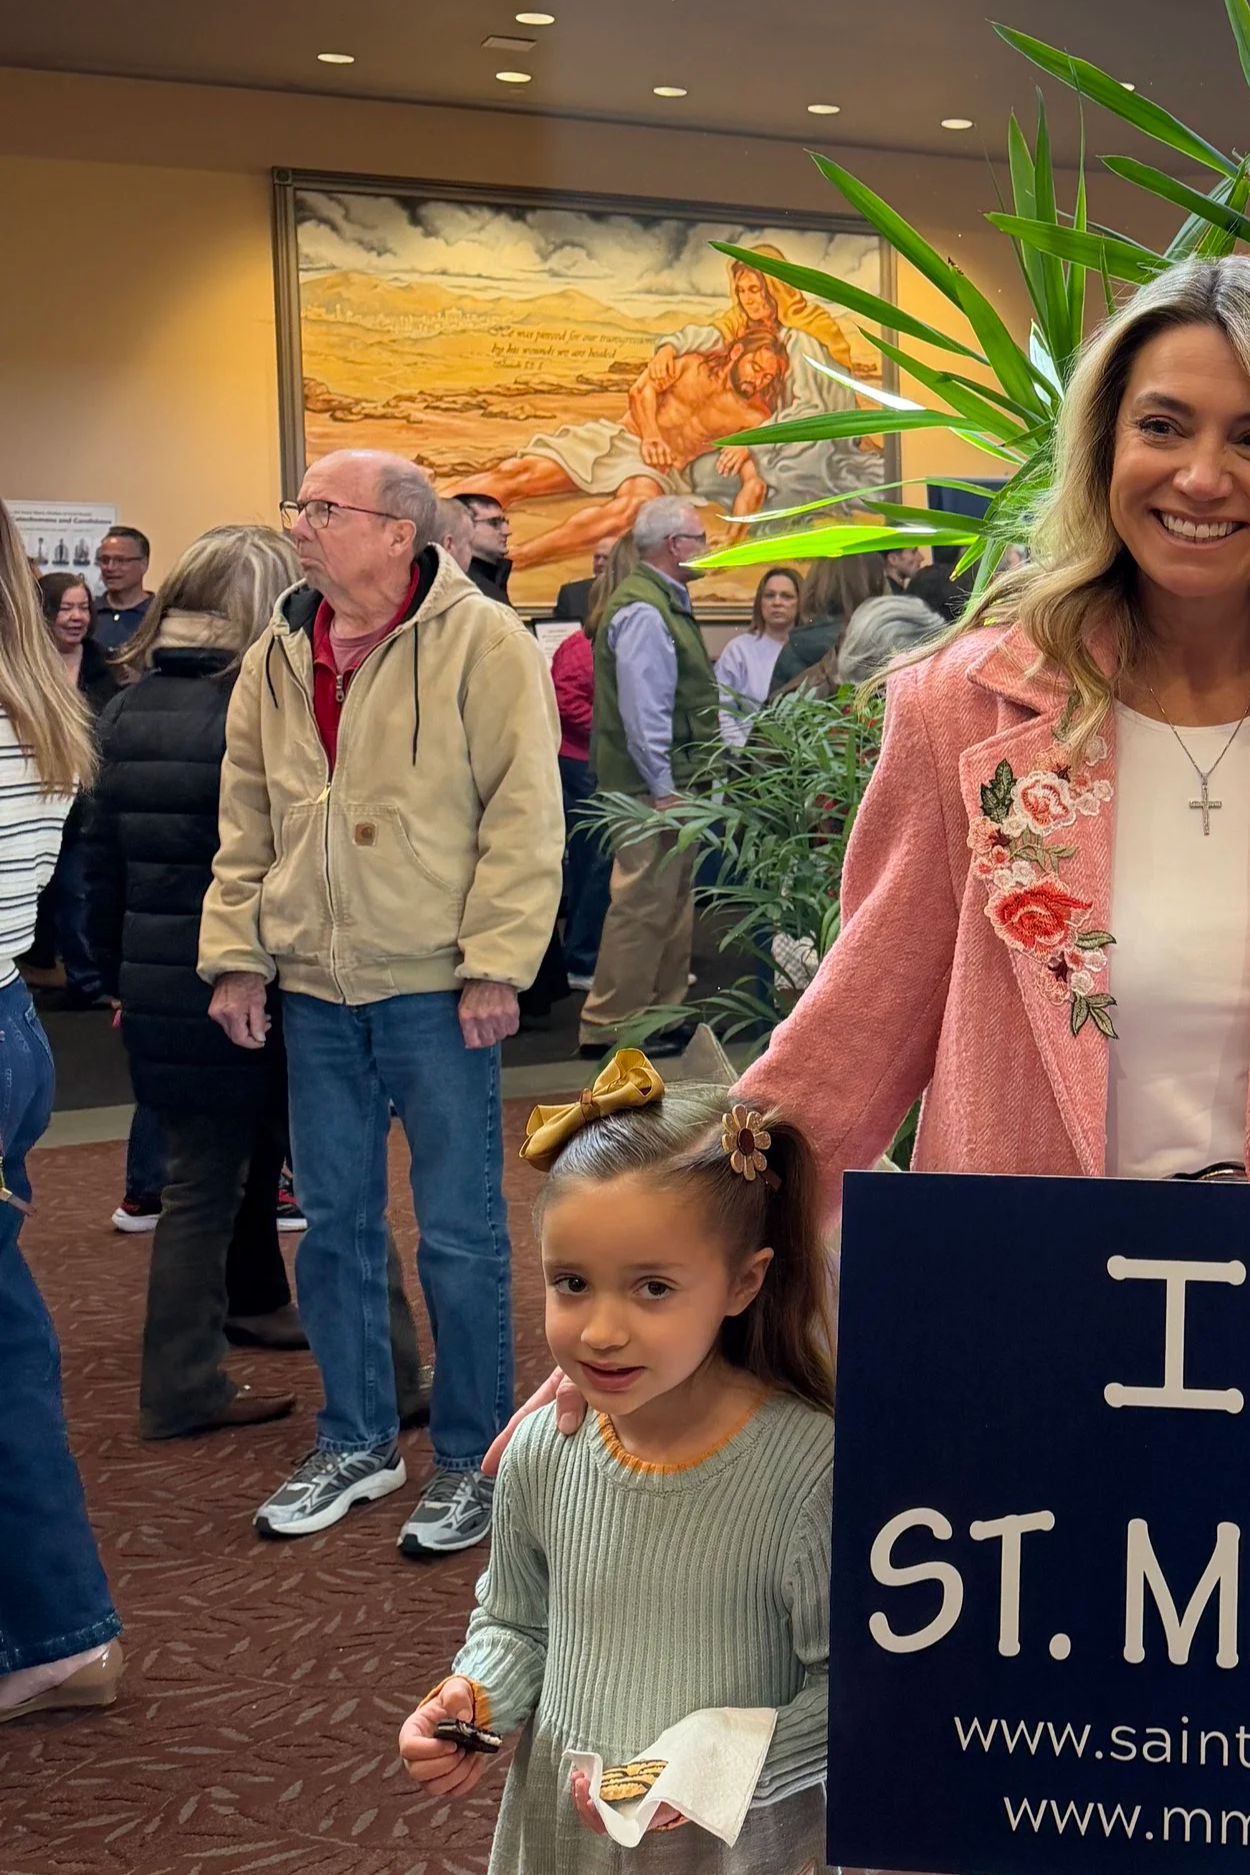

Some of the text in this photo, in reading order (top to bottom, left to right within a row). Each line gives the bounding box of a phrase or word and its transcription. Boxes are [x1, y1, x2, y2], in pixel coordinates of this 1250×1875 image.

[492, 343, 504, 357] by
[507, 343, 519, 354] his
[567, 330, 581, 344] for
[1104, 1255, 1246, 1413] I
[869, 1508, 1071, 1660] ST.
